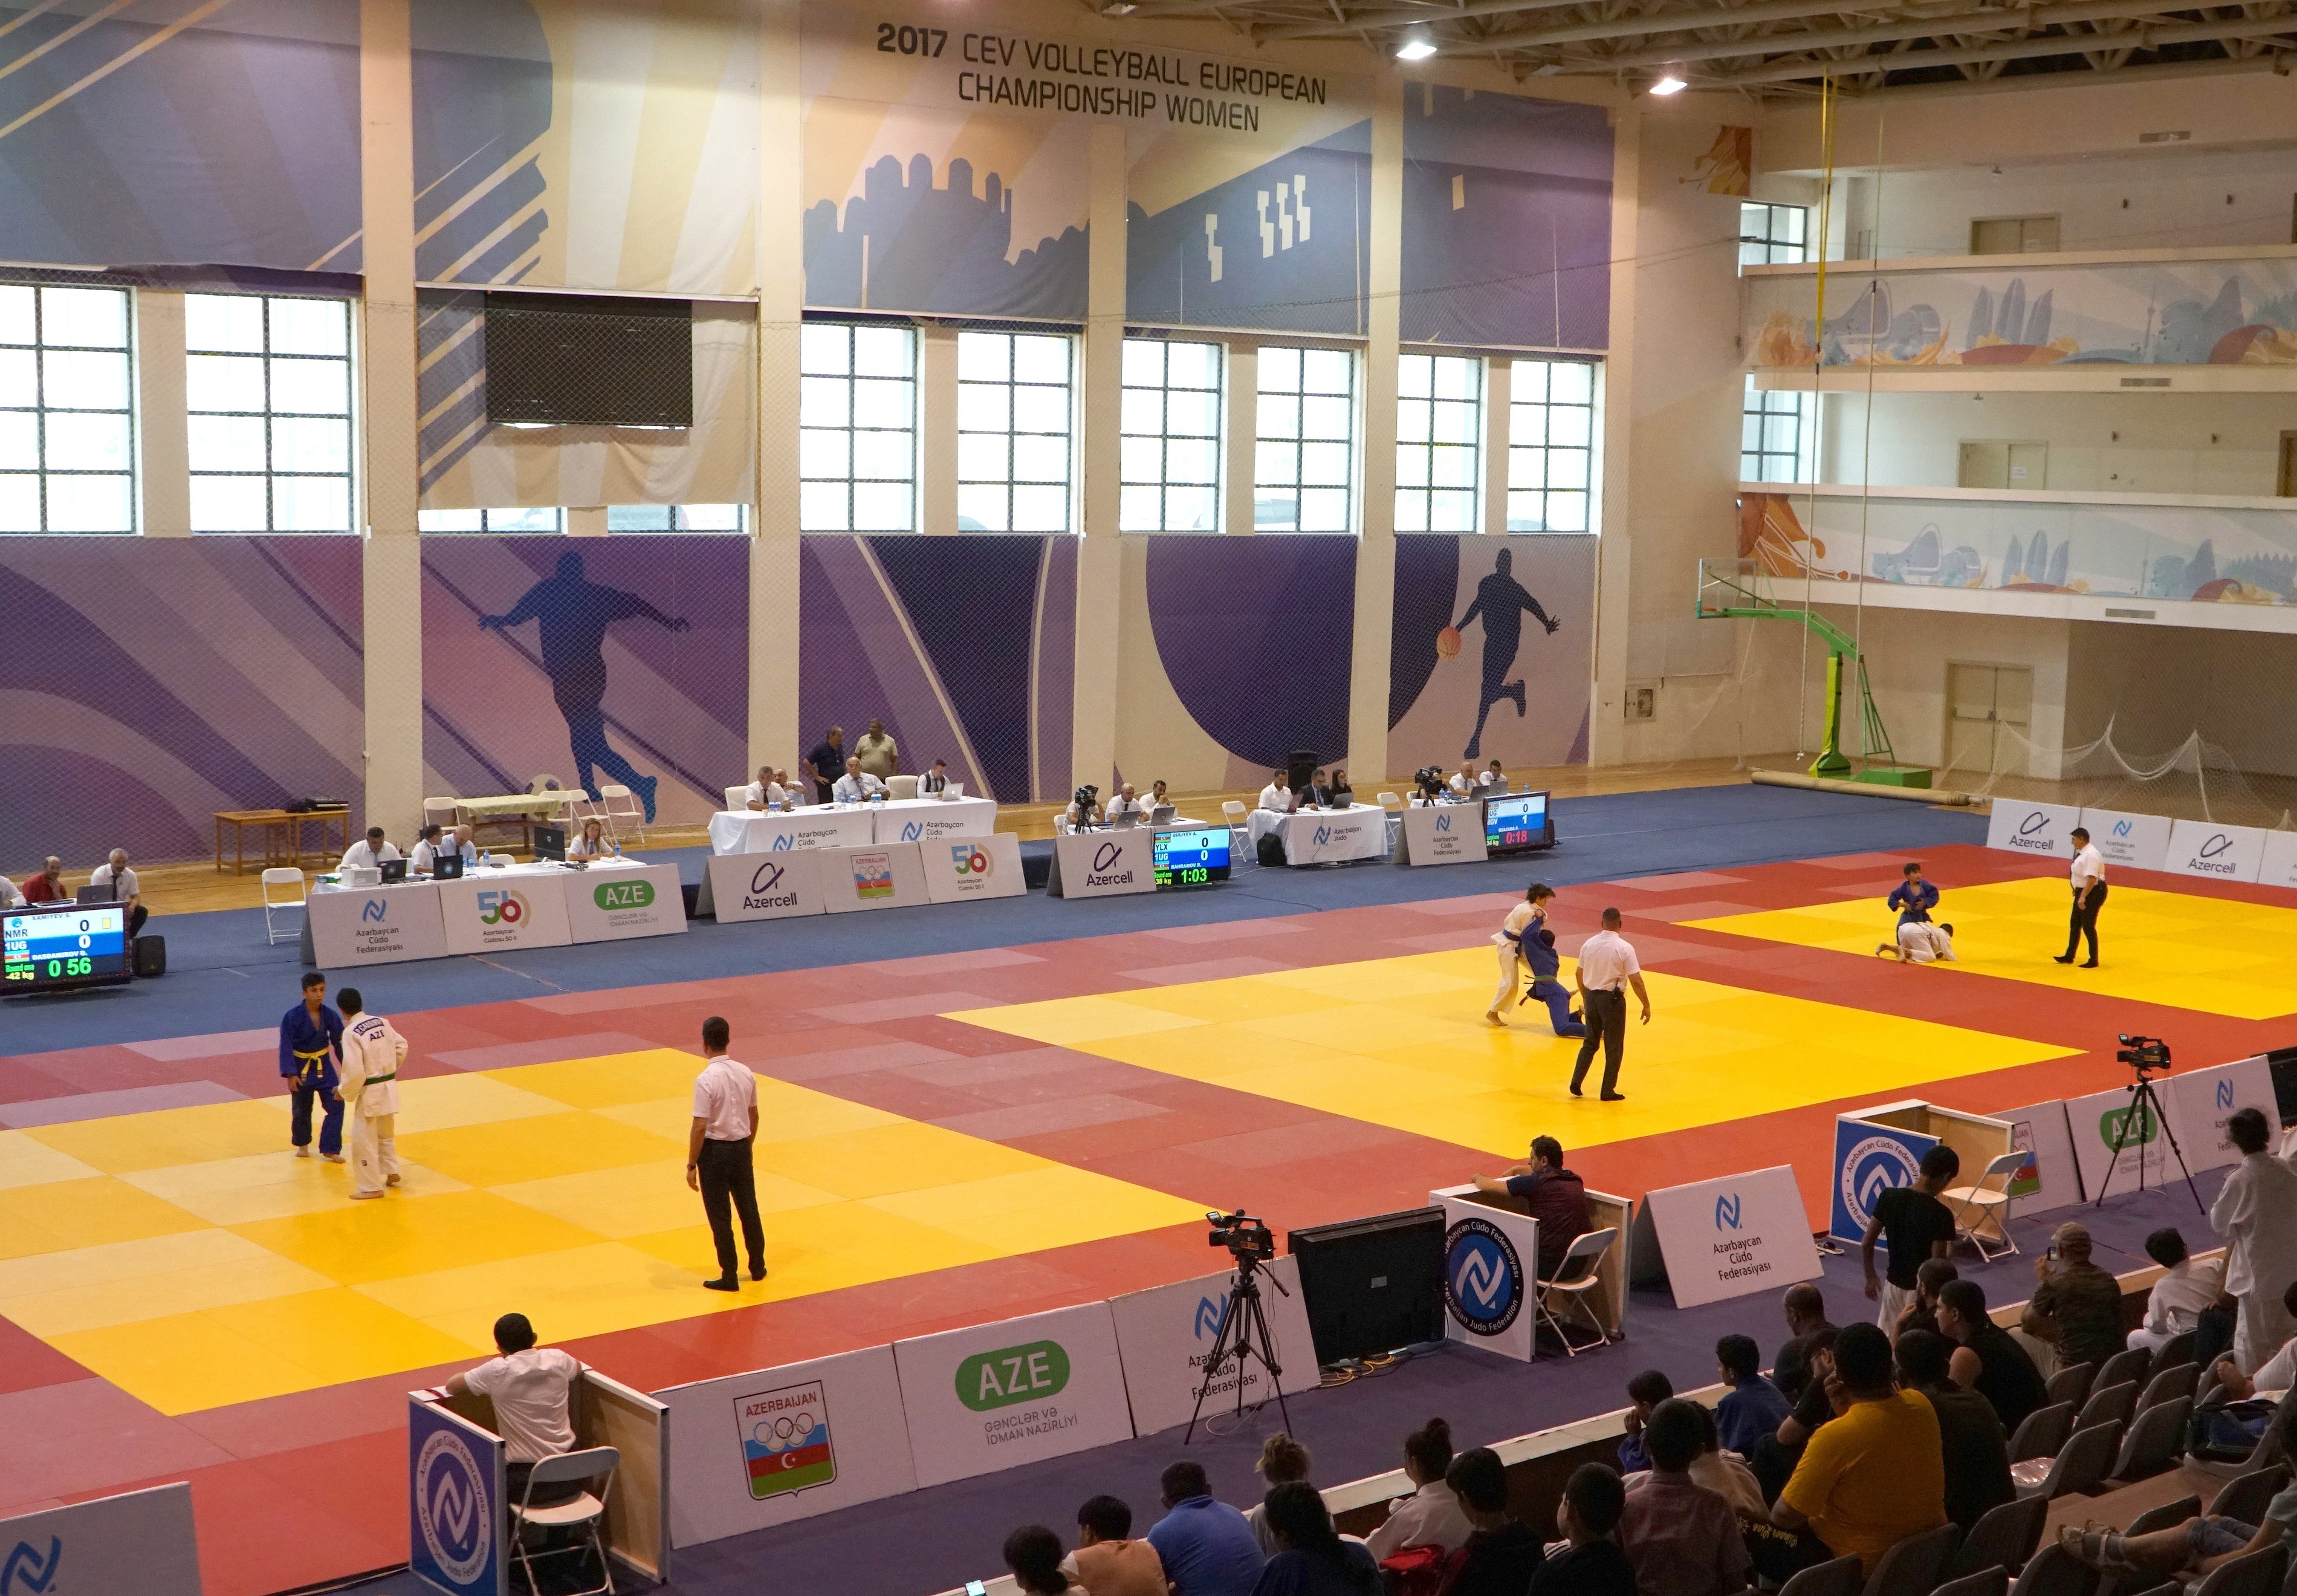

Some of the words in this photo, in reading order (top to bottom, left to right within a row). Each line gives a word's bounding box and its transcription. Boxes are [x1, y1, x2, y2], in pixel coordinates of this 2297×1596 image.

[876, 22, 948, 58] 2017
[962, 33, 1016, 66] CEV
[1024, 39, 1190, 87] VOLLEYBALL
[1199, 62, 1326, 105] EUROPEAN
[958, 71, 1156, 118] CHAMPIONSHIP
[1165, 92, 1259, 132] WOMEN
[1523, 803, 1528, 813] 0
[1521, 814, 1528, 825] 1
[797, 829, 837, 838] Azərbaycan
[1202, 837, 1208, 848] 0
[1505, 829, 1528, 845] 0:18
[2009, 834, 2054, 850] Azercell
[1155, 853, 1168, 861] 1UG
[1200, 849, 1208, 861] 0
[2187, 857, 2237, 874] Azercell
[1086, 871, 1133, 887] Azercell
[1181, 868, 1208, 883] 1:03
[606, 884, 645, 906] AZE
[743, 892, 798, 910] Azercell
[4, 929, 28, 938] NMR
[79, 919, 89, 932] 0
[78, 934, 91, 949] 0
[66, 956, 92, 976] 56
[22, 971, 34, 981] kg
[1846, 1192, 1870, 1227] Azerbaija
[1445, 1223, 1470, 1254] zərbaycan
[1471, 1221, 1490, 1234] Cüdo
[1714, 1237, 1762, 1255] Azərbaycan
[1729, 1251, 1752, 1264] Cüdo
[1718, 1262, 1771, 1281] Federasiyası
[978, 1351, 1052, 1401] AZE
[1191, 1374, 1257, 1400] Fderasiası
[745, 1390, 817, 1418] AZERBAIJAN
[984, 1411, 1039, 1432] GƏNCLƏR
[1041, 1406, 1057, 1418] VƏ
[986, 1427, 1024, 1445] İDMAN
[1026, 1413, 1078, 1437] NAZİRLİYİ
